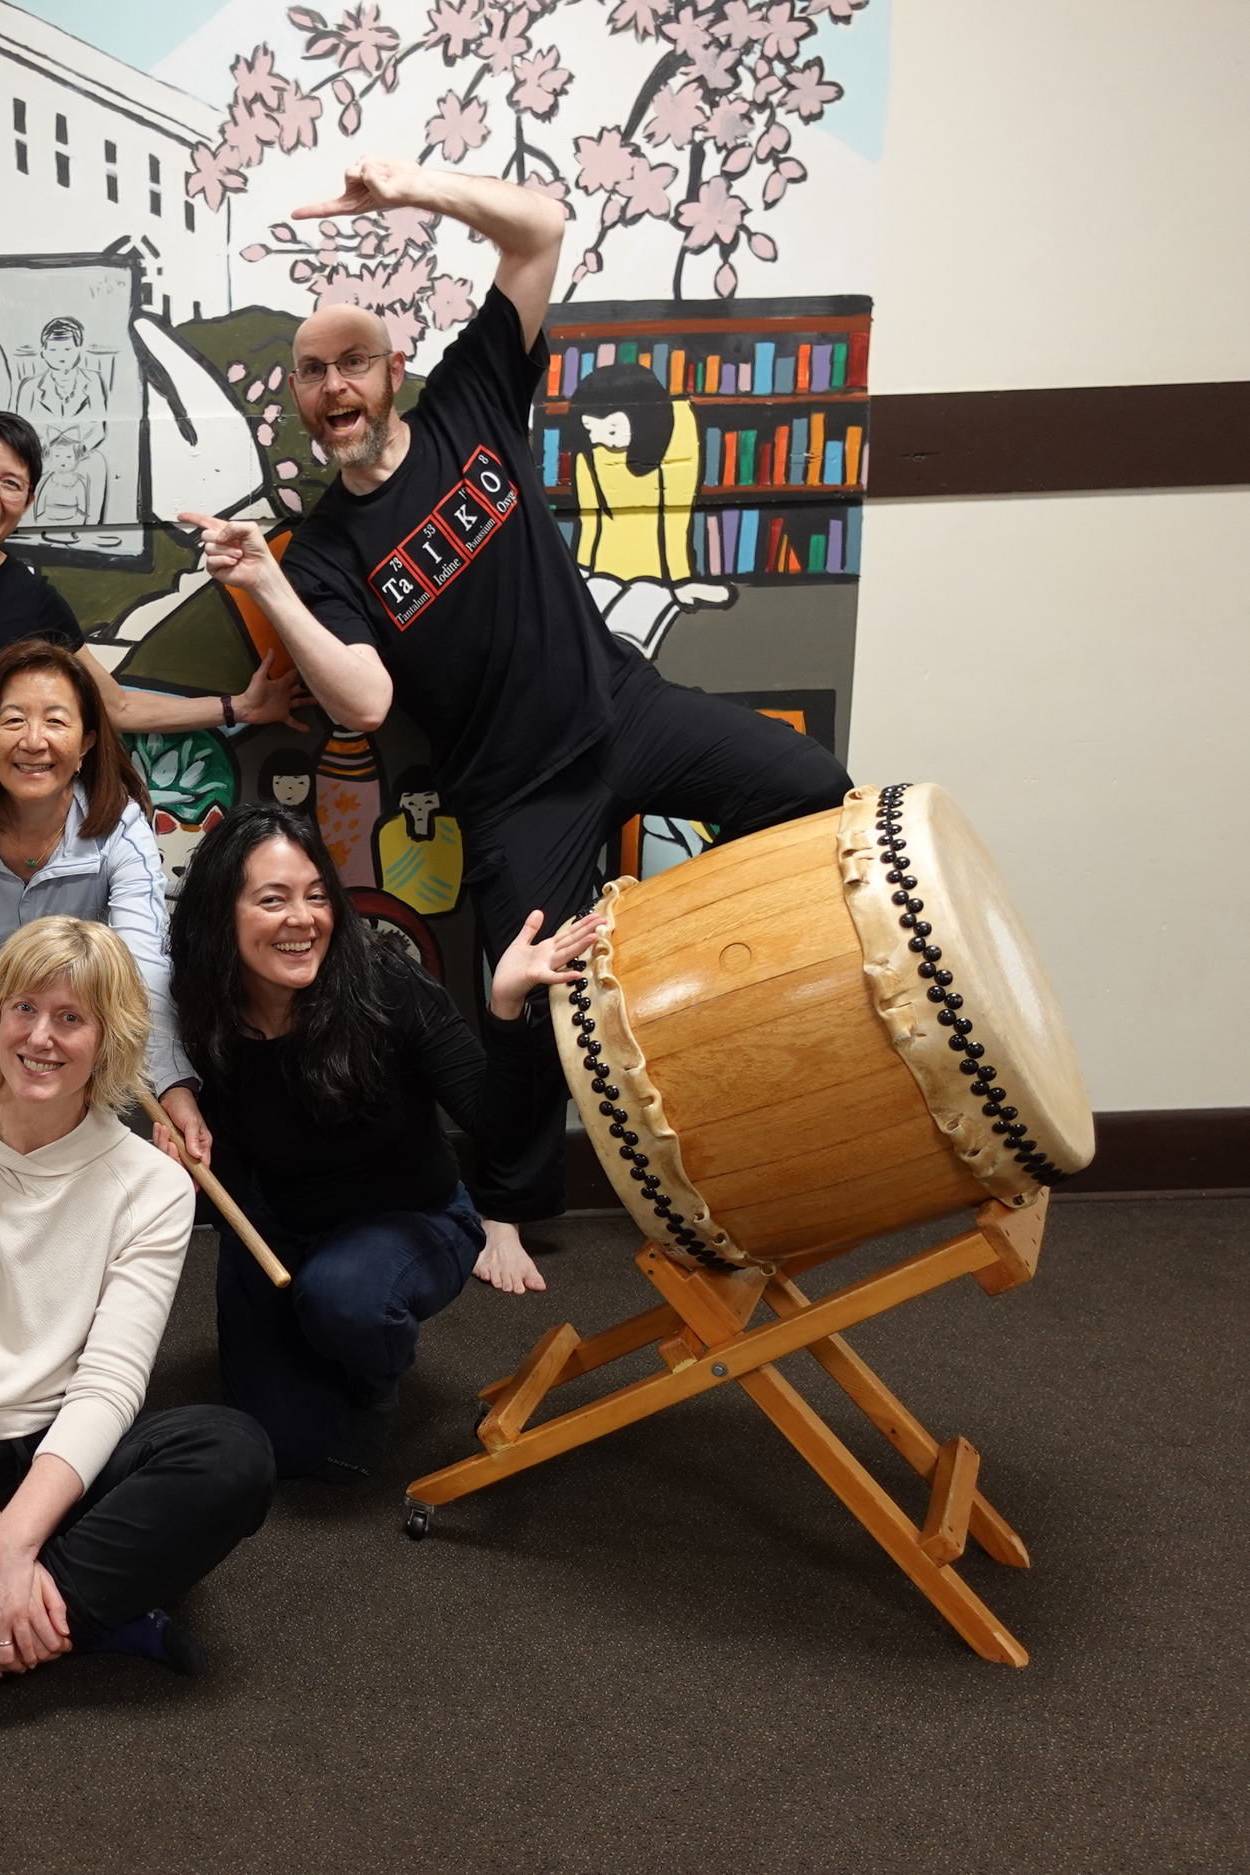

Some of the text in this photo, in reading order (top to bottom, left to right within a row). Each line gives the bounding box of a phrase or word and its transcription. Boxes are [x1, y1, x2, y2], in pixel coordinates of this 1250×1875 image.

[381, 470, 501, 604] Ta I K O
[389, 556, 403, 572] 73
[422, 523, 436, 538] 53
[478, 454, 489, 465] 8
[394, 591, 431, 625] Tantalum
[432, 558, 462, 586] Iodine
[465, 518, 496, 553] Potassium
